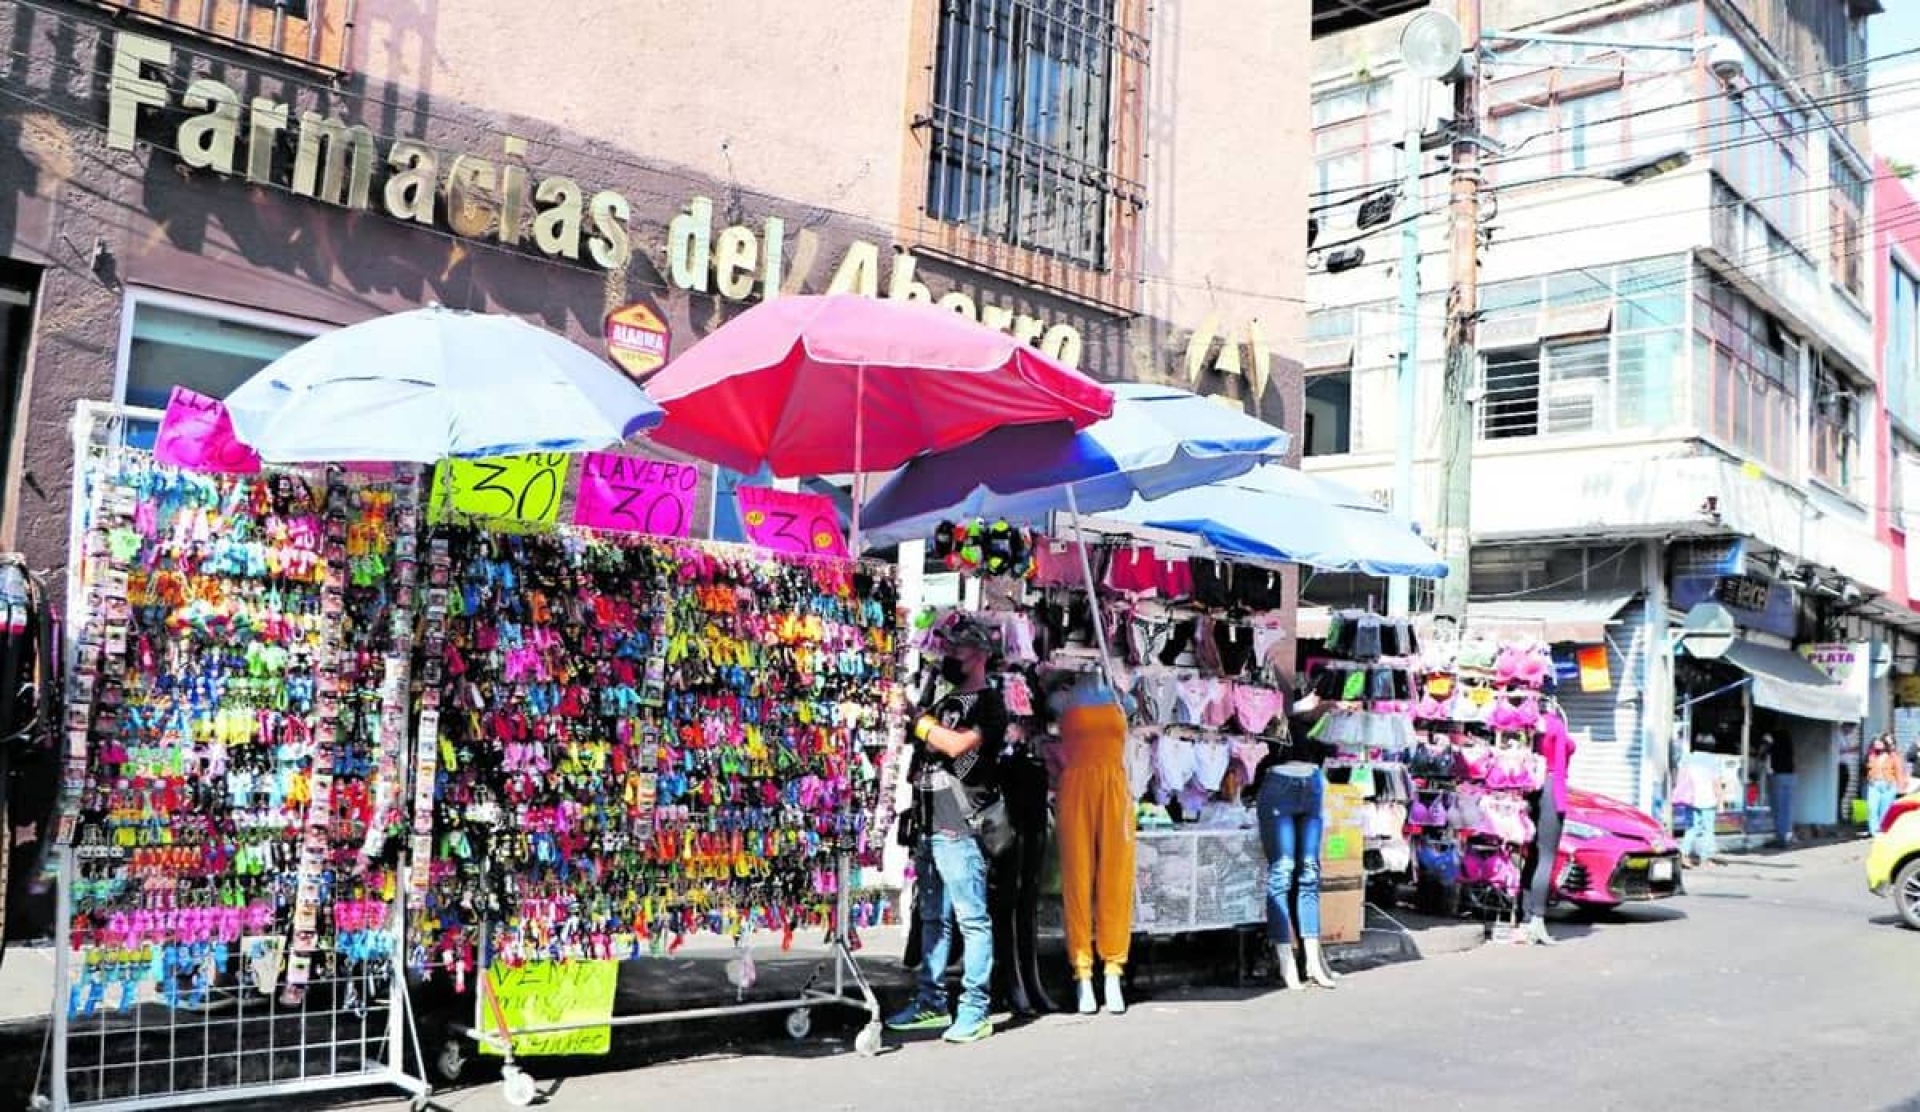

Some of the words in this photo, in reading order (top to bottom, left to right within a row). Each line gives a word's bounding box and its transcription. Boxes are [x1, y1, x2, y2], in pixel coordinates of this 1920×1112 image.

[106, 31, 630, 271] Farmacias
[667, 196, 785, 300] del
[472, 462, 557, 520] 30
[584, 451, 698, 492] LLAVERO
[611, 484, 684, 536] 30
[769, 511, 846, 558] 30
[1807, 652, 1856, 664] PLATA
